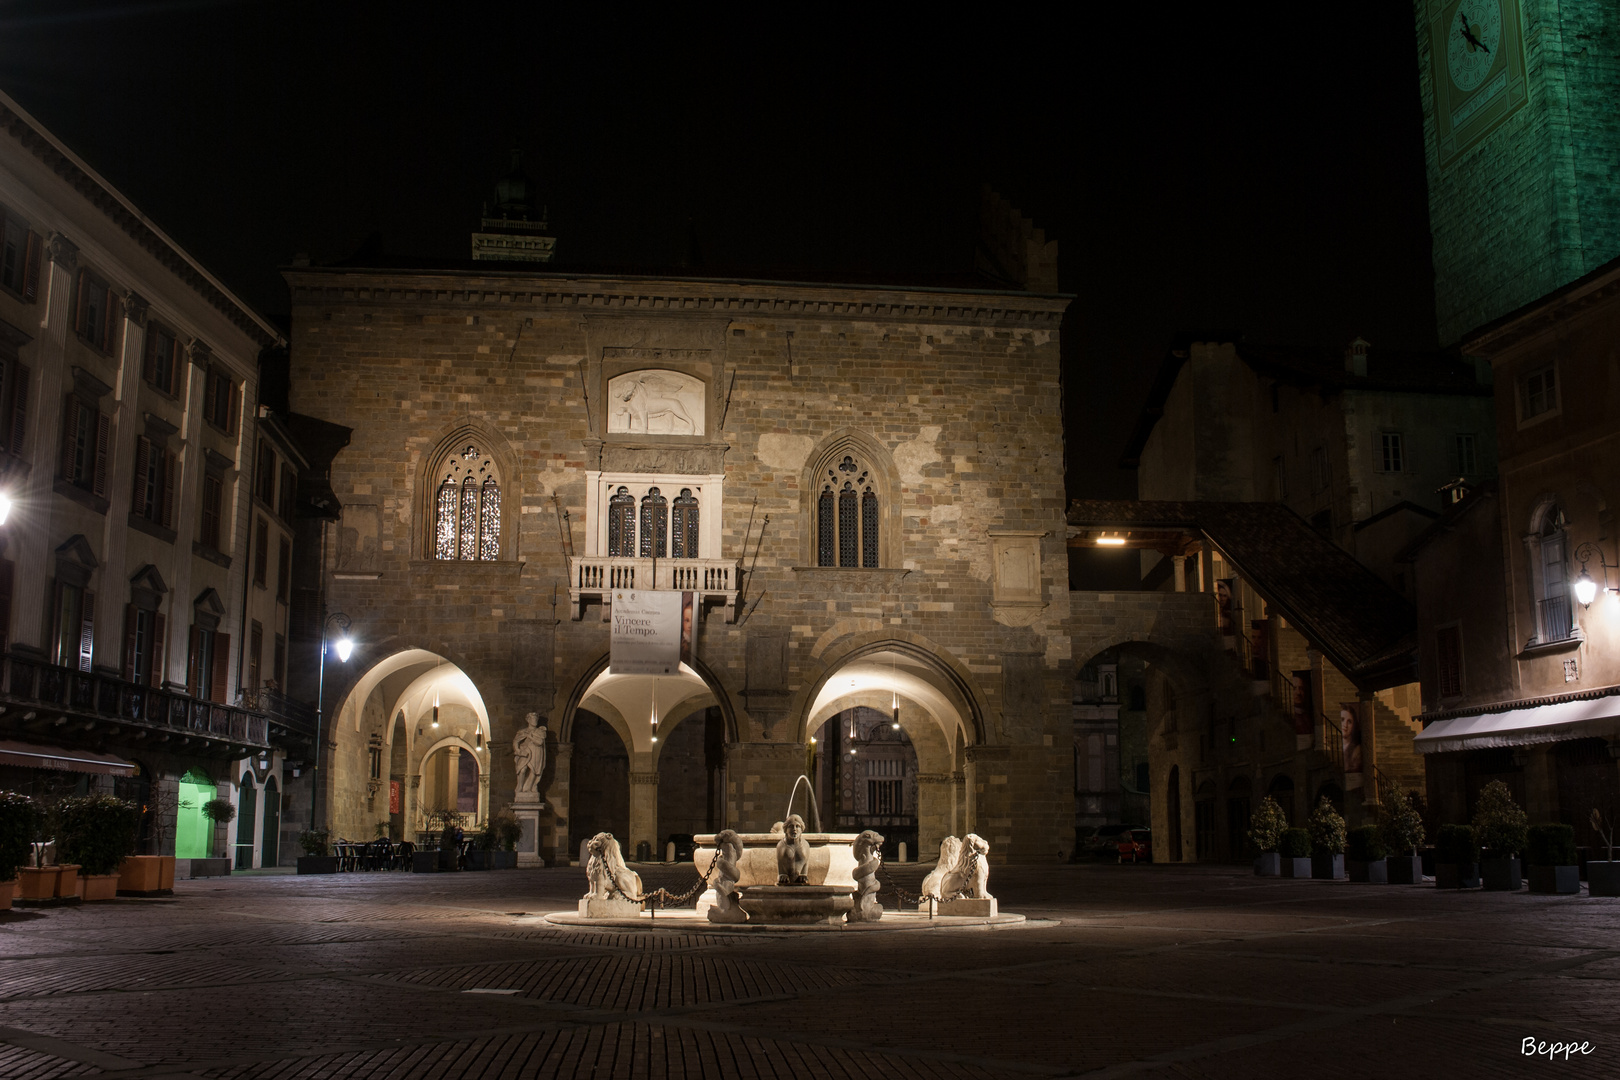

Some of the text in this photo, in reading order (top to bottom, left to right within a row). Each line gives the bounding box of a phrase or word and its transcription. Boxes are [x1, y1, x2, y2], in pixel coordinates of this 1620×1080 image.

[615, 615, 651, 626] Vincere
[614, 625, 658, 637] il Tempo.
